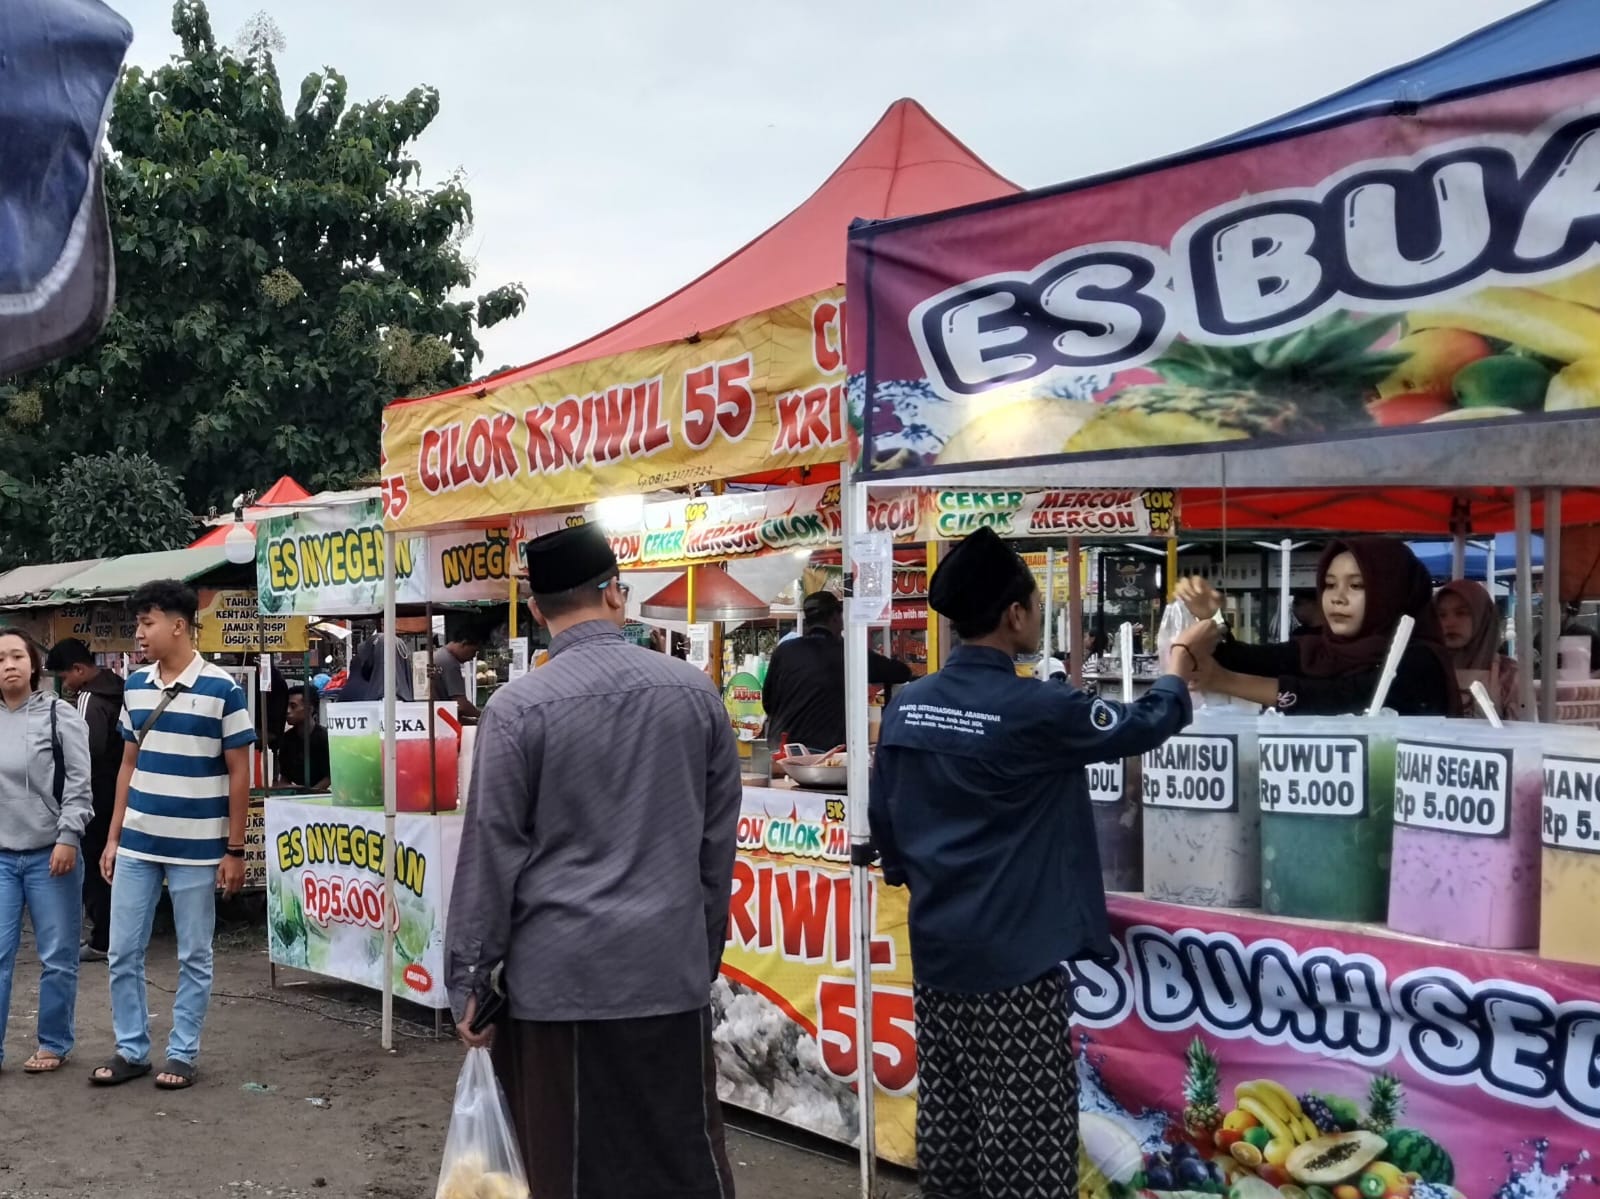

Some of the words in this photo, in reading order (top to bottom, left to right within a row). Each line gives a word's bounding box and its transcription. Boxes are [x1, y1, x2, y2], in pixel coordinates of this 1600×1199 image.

[923, 252, 1166, 395] ES
[420, 414, 518, 493] CILOK
[526, 380, 670, 473] KRIWIL
[685, 356, 753, 446] 55
[774, 384, 848, 450] KRI
[939, 490, 1023, 510] CEKER
[1037, 491, 1132, 510] MERCON
[1143, 489, 1173, 508] 10K
[643, 529, 684, 556] CEKER
[687, 522, 758, 553] MERCON
[761, 512, 826, 542] CILOK
[939, 511, 1013, 531] CILOK
[1031, 510, 1135, 529] MERCON
[1150, 511, 1171, 531] 5K
[269, 537, 299, 592] ES
[216, 611, 258, 619] KENTANG
[225, 598, 250, 606] TAHU
[222, 623, 253, 631] JAMUR
[253, 635, 283, 644] KISPI
[328, 717, 368, 729] UWUT
[1259, 743, 1357, 773] KUWUT
[1436, 756, 1500, 791] SEGAR
[1089, 768, 1119, 792] DUL
[1143, 773, 1161, 802] Rp
[1166, 775, 1226, 801] 5.000
[1260, 782, 1281, 809] Rp
[1288, 780, 1355, 806] 5.000
[1543, 768, 1600, 802] MAN
[825, 799, 845, 821] 5K
[1395, 787, 1416, 821] Rp
[1423, 791, 1496, 825] 5.000
[768, 820, 820, 851] CILOK
[1543, 805, 1568, 843] Rp
[277, 826, 304, 872] ES
[306, 823, 426, 897] NYEGEIN
[726, 860, 892, 963] RIWIL
[1132, 931, 1391, 1058] BUAH
[820, 981, 916, 1091] 55
